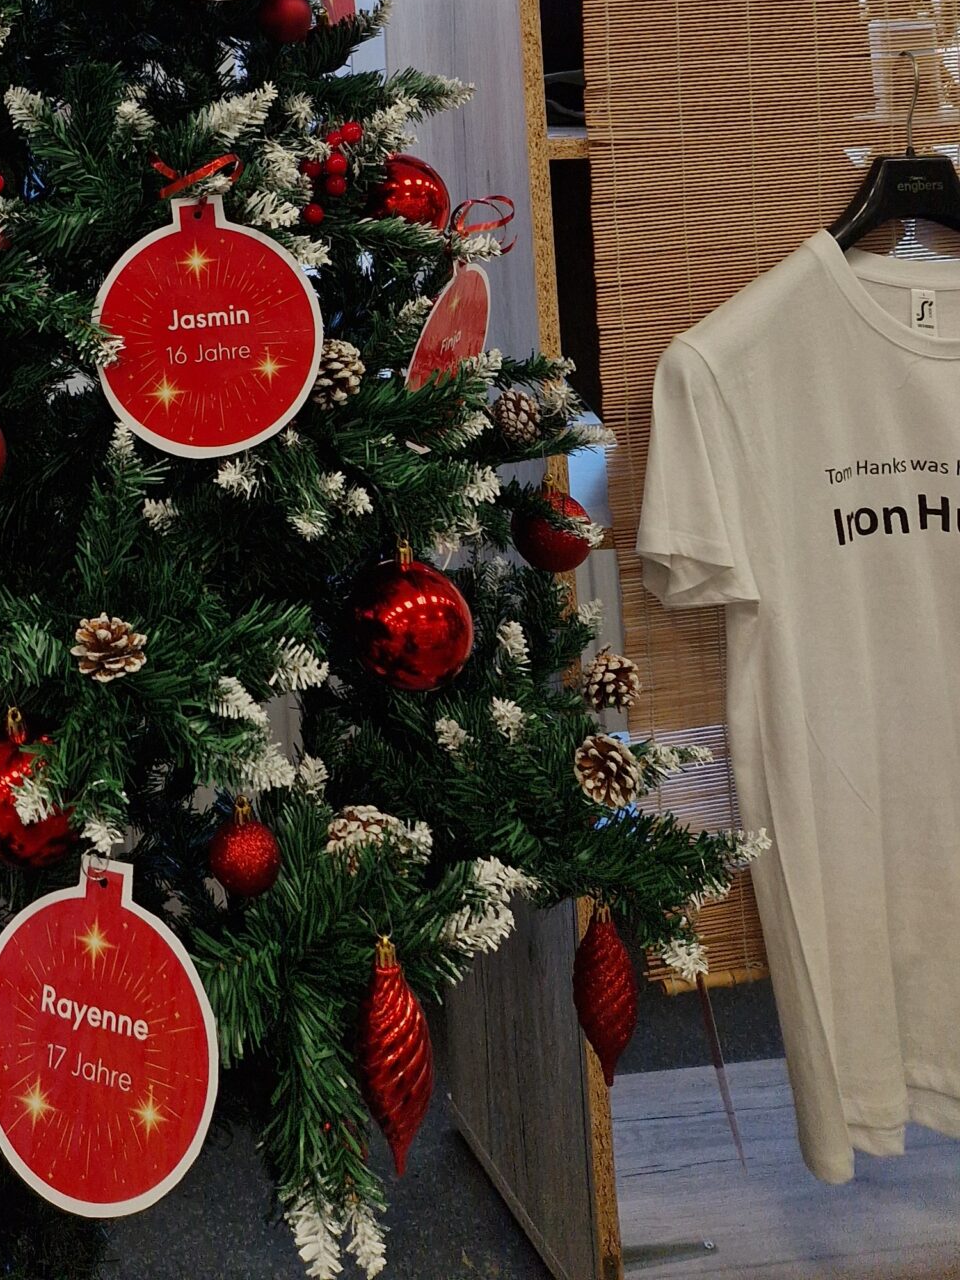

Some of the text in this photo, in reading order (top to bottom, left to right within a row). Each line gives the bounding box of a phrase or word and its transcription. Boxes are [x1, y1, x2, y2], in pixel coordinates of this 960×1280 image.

[897, 180, 944, 193] engbers
[168, 304, 250, 331] Jasmin
[166, 342, 251, 365] 16 Jahre
[440, 330, 462, 355] Finja
[825, 467, 853, 485] Tom
[856, 457, 907, 476] Hanks
[910, 459, 949, 475] was
[834, 506, 910, 546] Iron
[40, 983, 149, 1041] Rayenne
[47, 1043, 133, 1092] 17 Jahre
